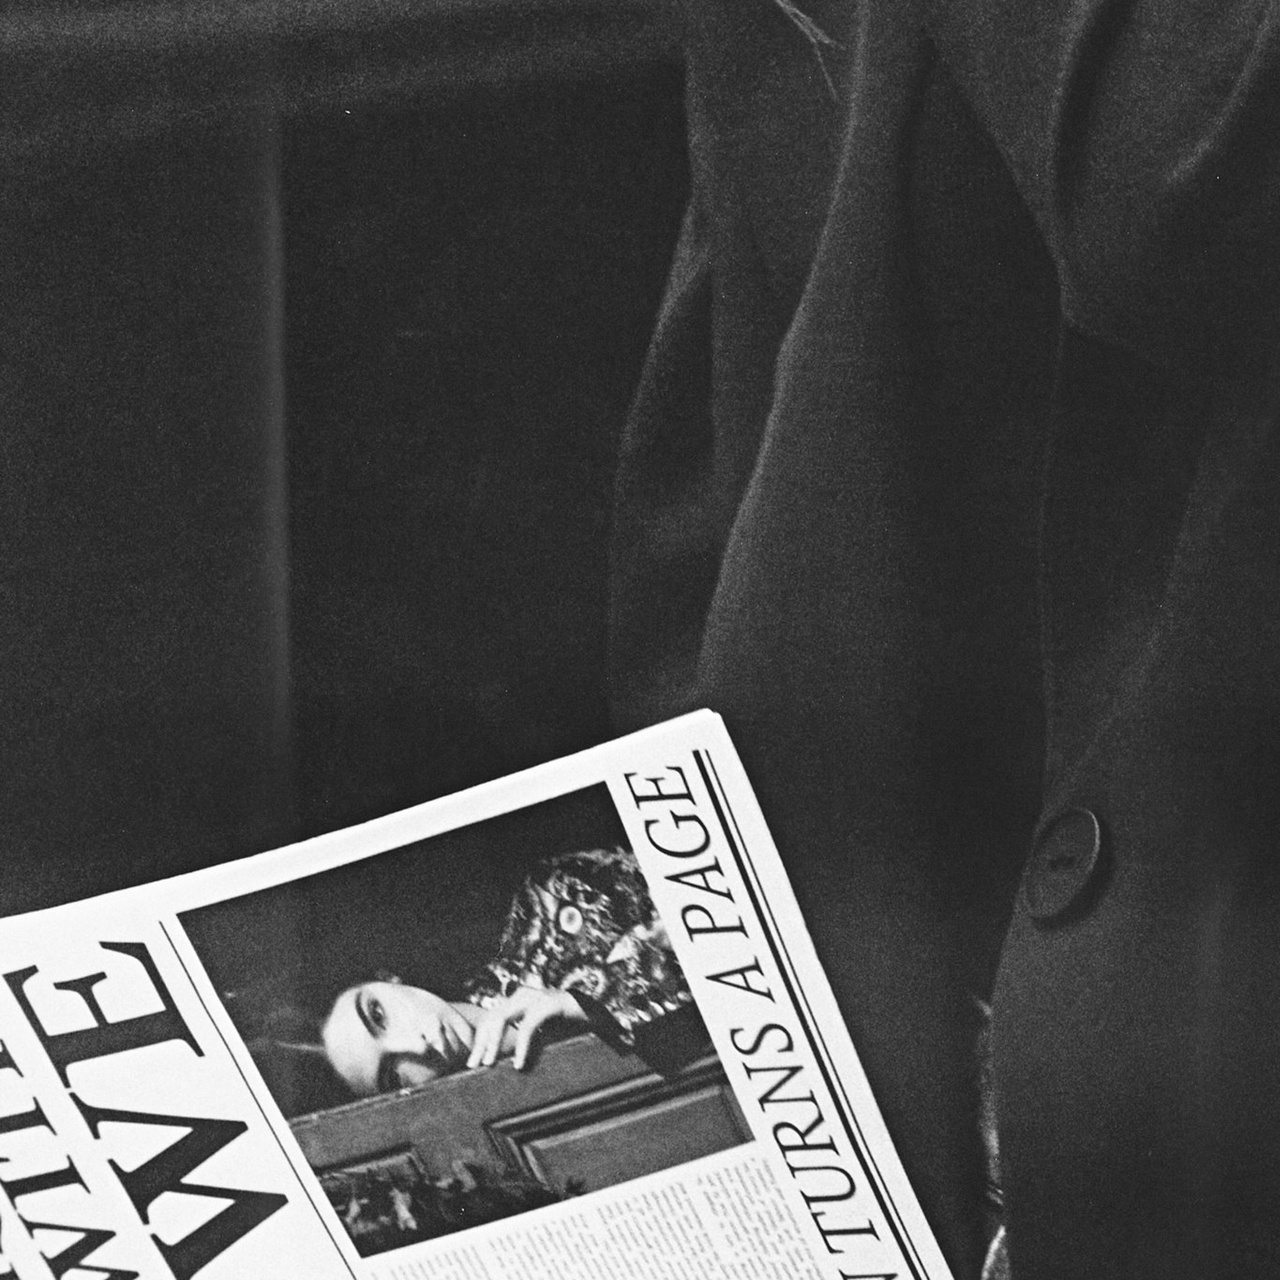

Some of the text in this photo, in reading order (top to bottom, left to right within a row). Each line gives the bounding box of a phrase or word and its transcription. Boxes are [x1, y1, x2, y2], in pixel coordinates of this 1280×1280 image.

[623, 766, 749, 942] PAGE
[705, 956, 777, 1004] A
[2, 941, 289, 1280] WE
[729, 1023, 882, 1256] TURNS
